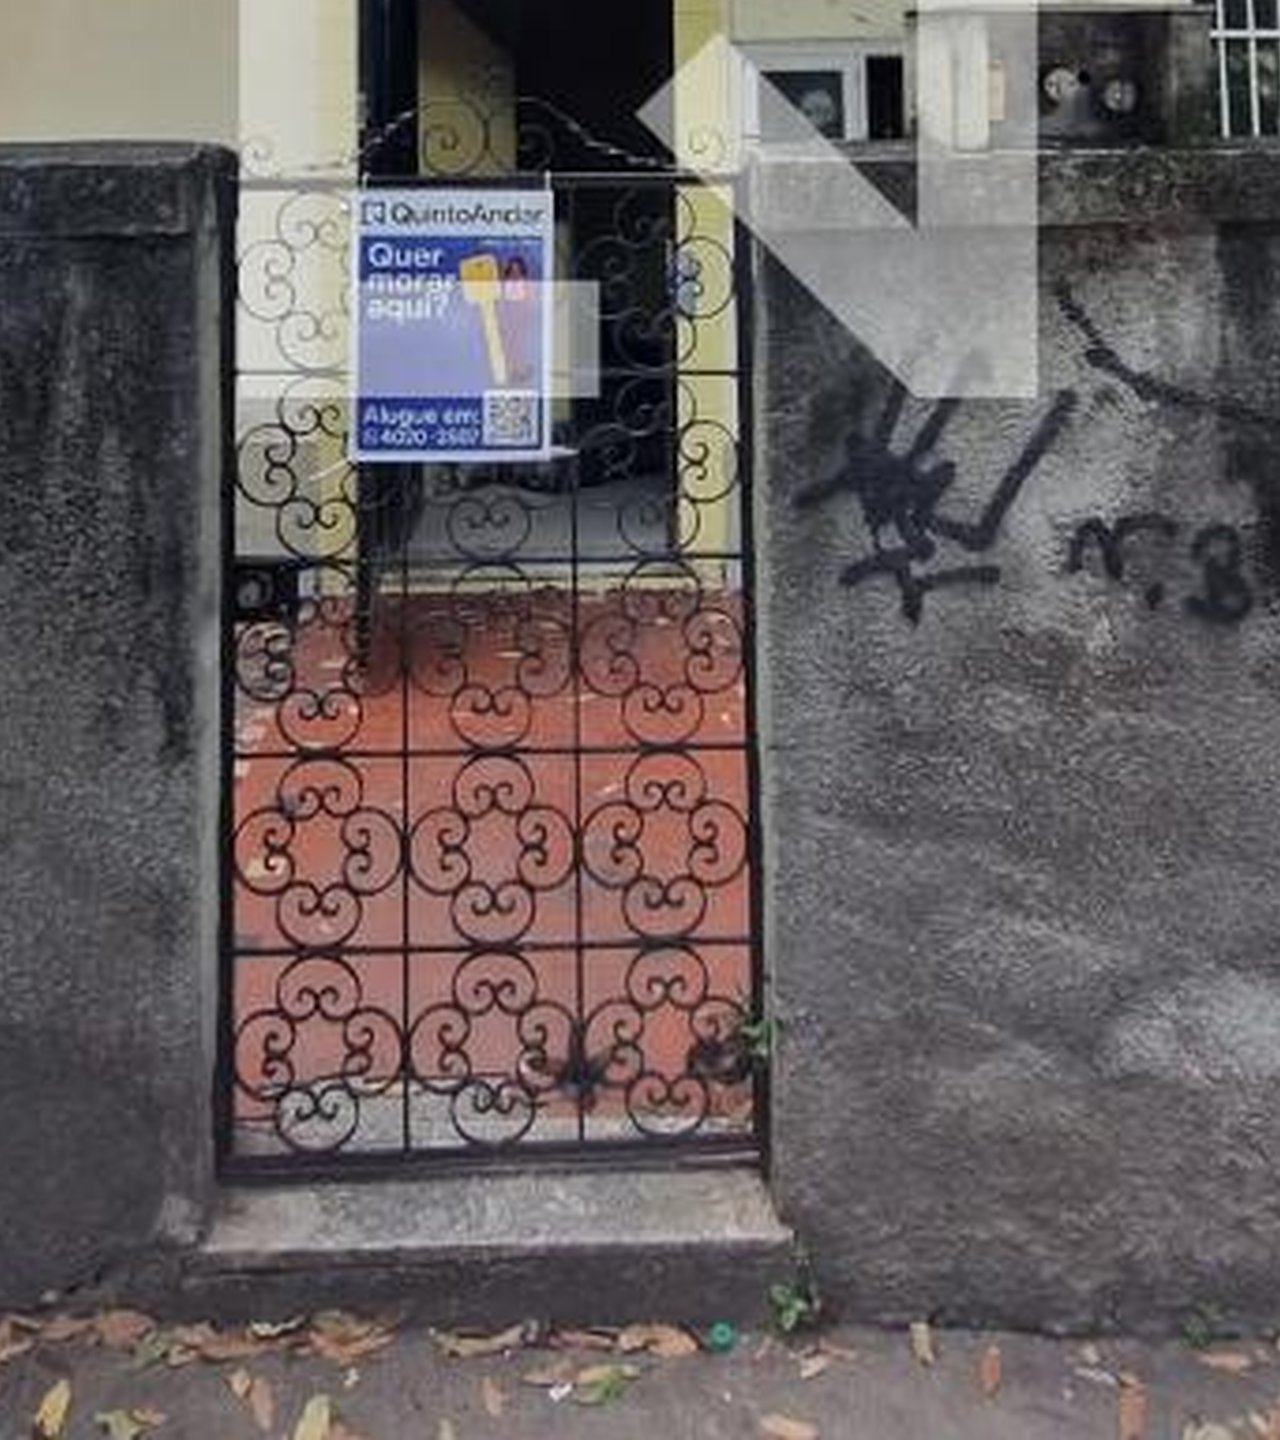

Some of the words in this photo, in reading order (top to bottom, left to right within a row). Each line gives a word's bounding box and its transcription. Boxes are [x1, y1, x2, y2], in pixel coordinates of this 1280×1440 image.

[390, 202, 545, 226] QuintoAndar
[368, 242, 444, 268] Quer
[367, 272, 457, 295] morar
[367, 293, 450, 324] aqui?
[363, 404, 438, 427] Alugue
